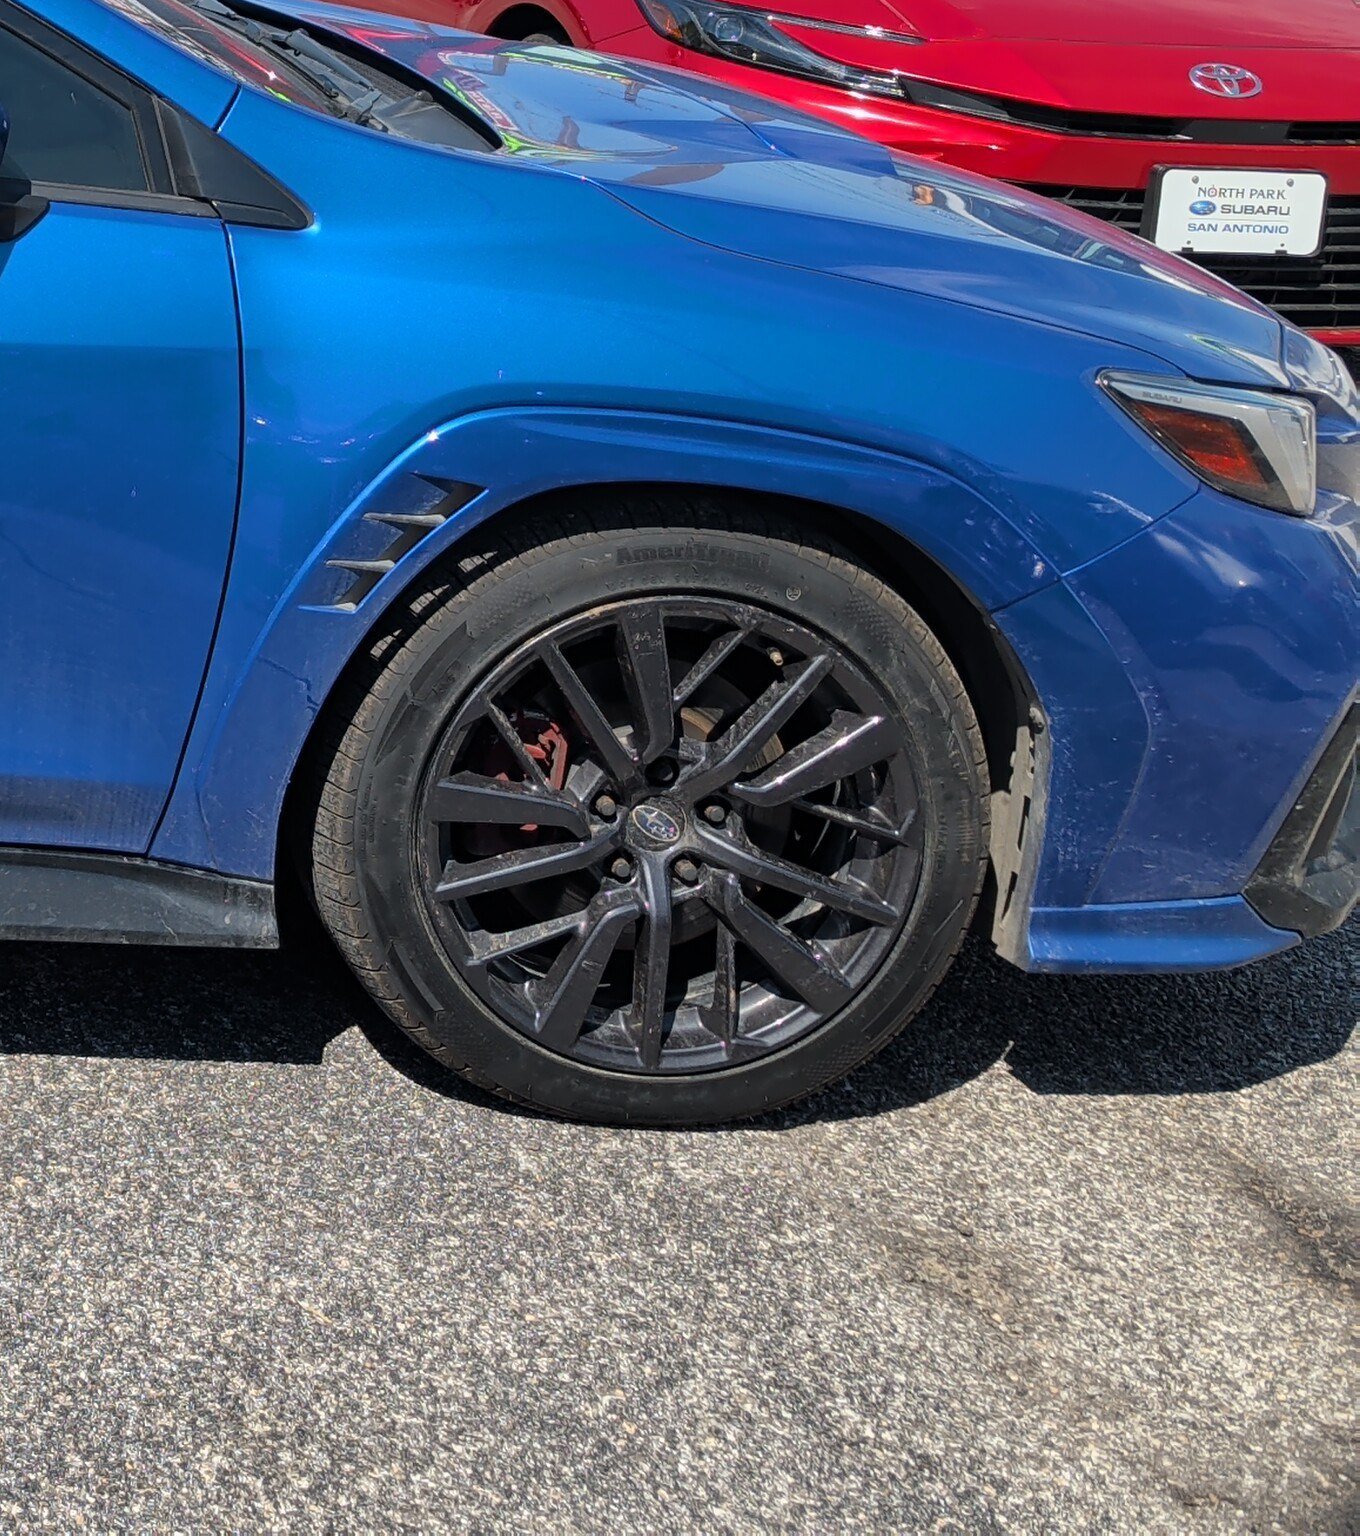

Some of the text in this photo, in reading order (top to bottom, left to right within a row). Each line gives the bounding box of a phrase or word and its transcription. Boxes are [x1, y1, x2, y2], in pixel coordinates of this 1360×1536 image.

[1197, 185, 1287, 200] NORTH PARK
[1220, 204, 1291, 216] SUBARU
[1187, 223, 1289, 234] SAN ANTONIO
[1142, 391, 1183, 404] SUBARU
